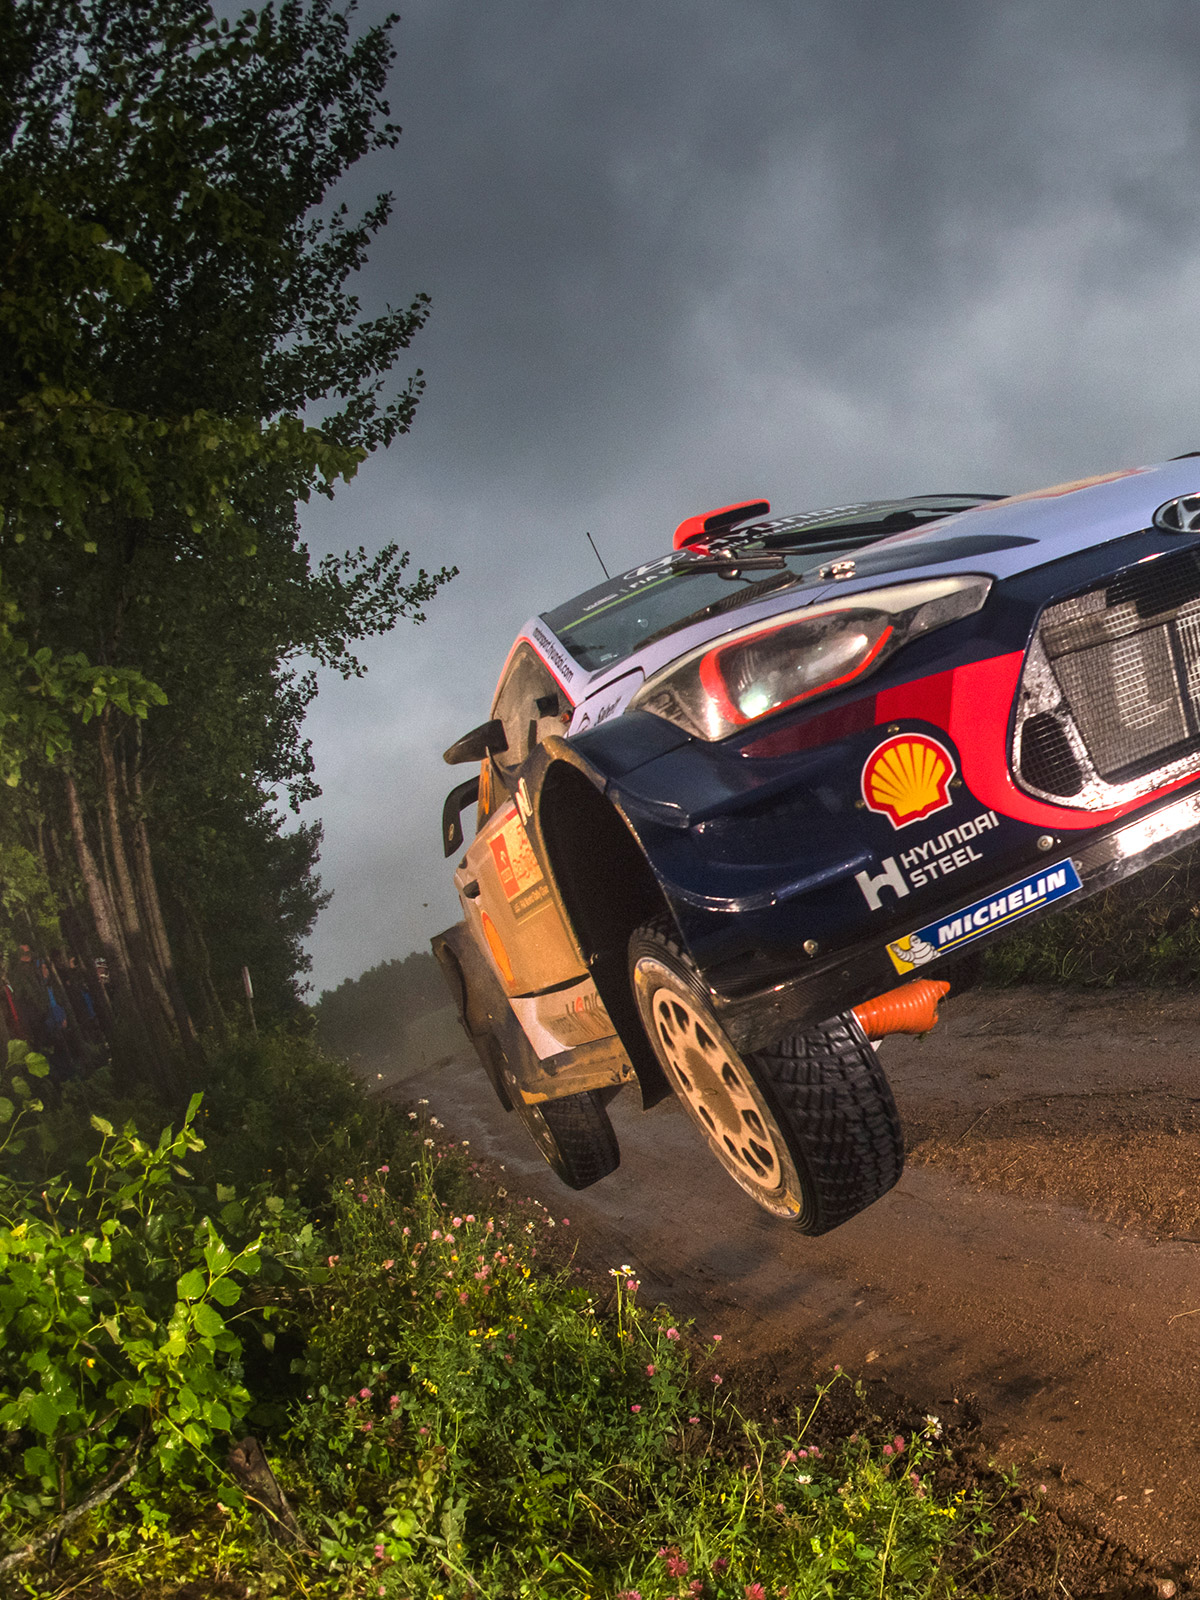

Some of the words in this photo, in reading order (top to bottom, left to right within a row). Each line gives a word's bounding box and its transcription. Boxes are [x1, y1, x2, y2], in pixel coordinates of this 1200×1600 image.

[629, 575, 658, 588] FIA
[533, 627, 574, 683] motorsport.hyundai.com
[900, 810, 1000, 869] HYUNDAI
[909, 845, 983, 889] STEEL
[938, 868, 1067, 945] MICHELIN
